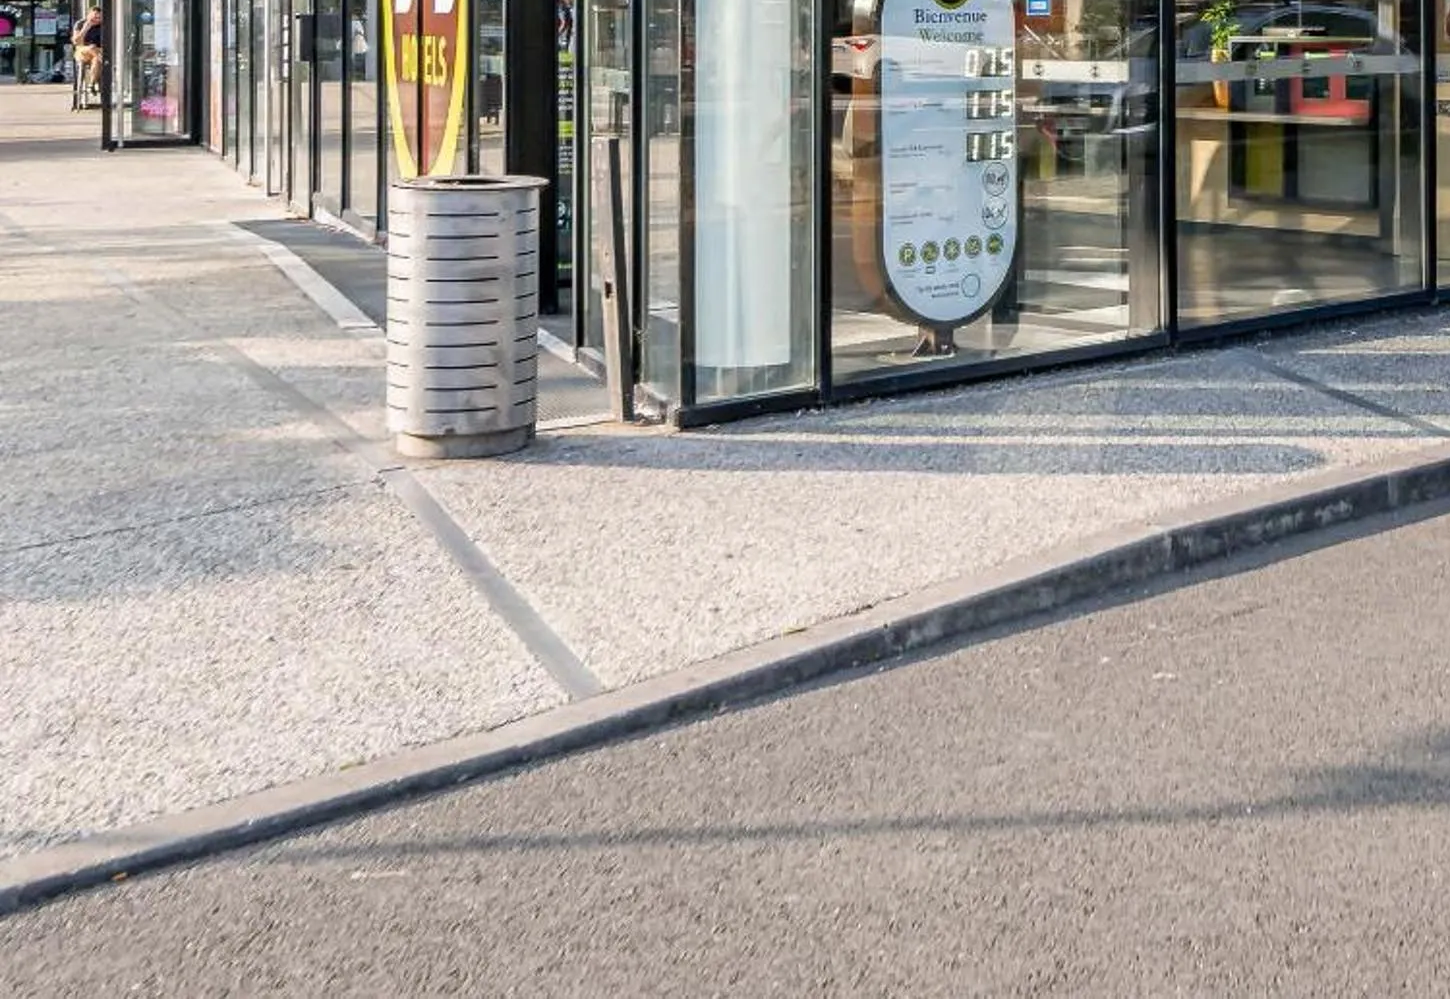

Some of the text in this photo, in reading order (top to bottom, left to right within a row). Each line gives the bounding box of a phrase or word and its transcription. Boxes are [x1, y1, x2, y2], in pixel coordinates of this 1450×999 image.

[913, 8, 988, 24] Bienvenue
[918, 27, 986, 44] Welcome
[401, 33, 448, 88] HOELS
